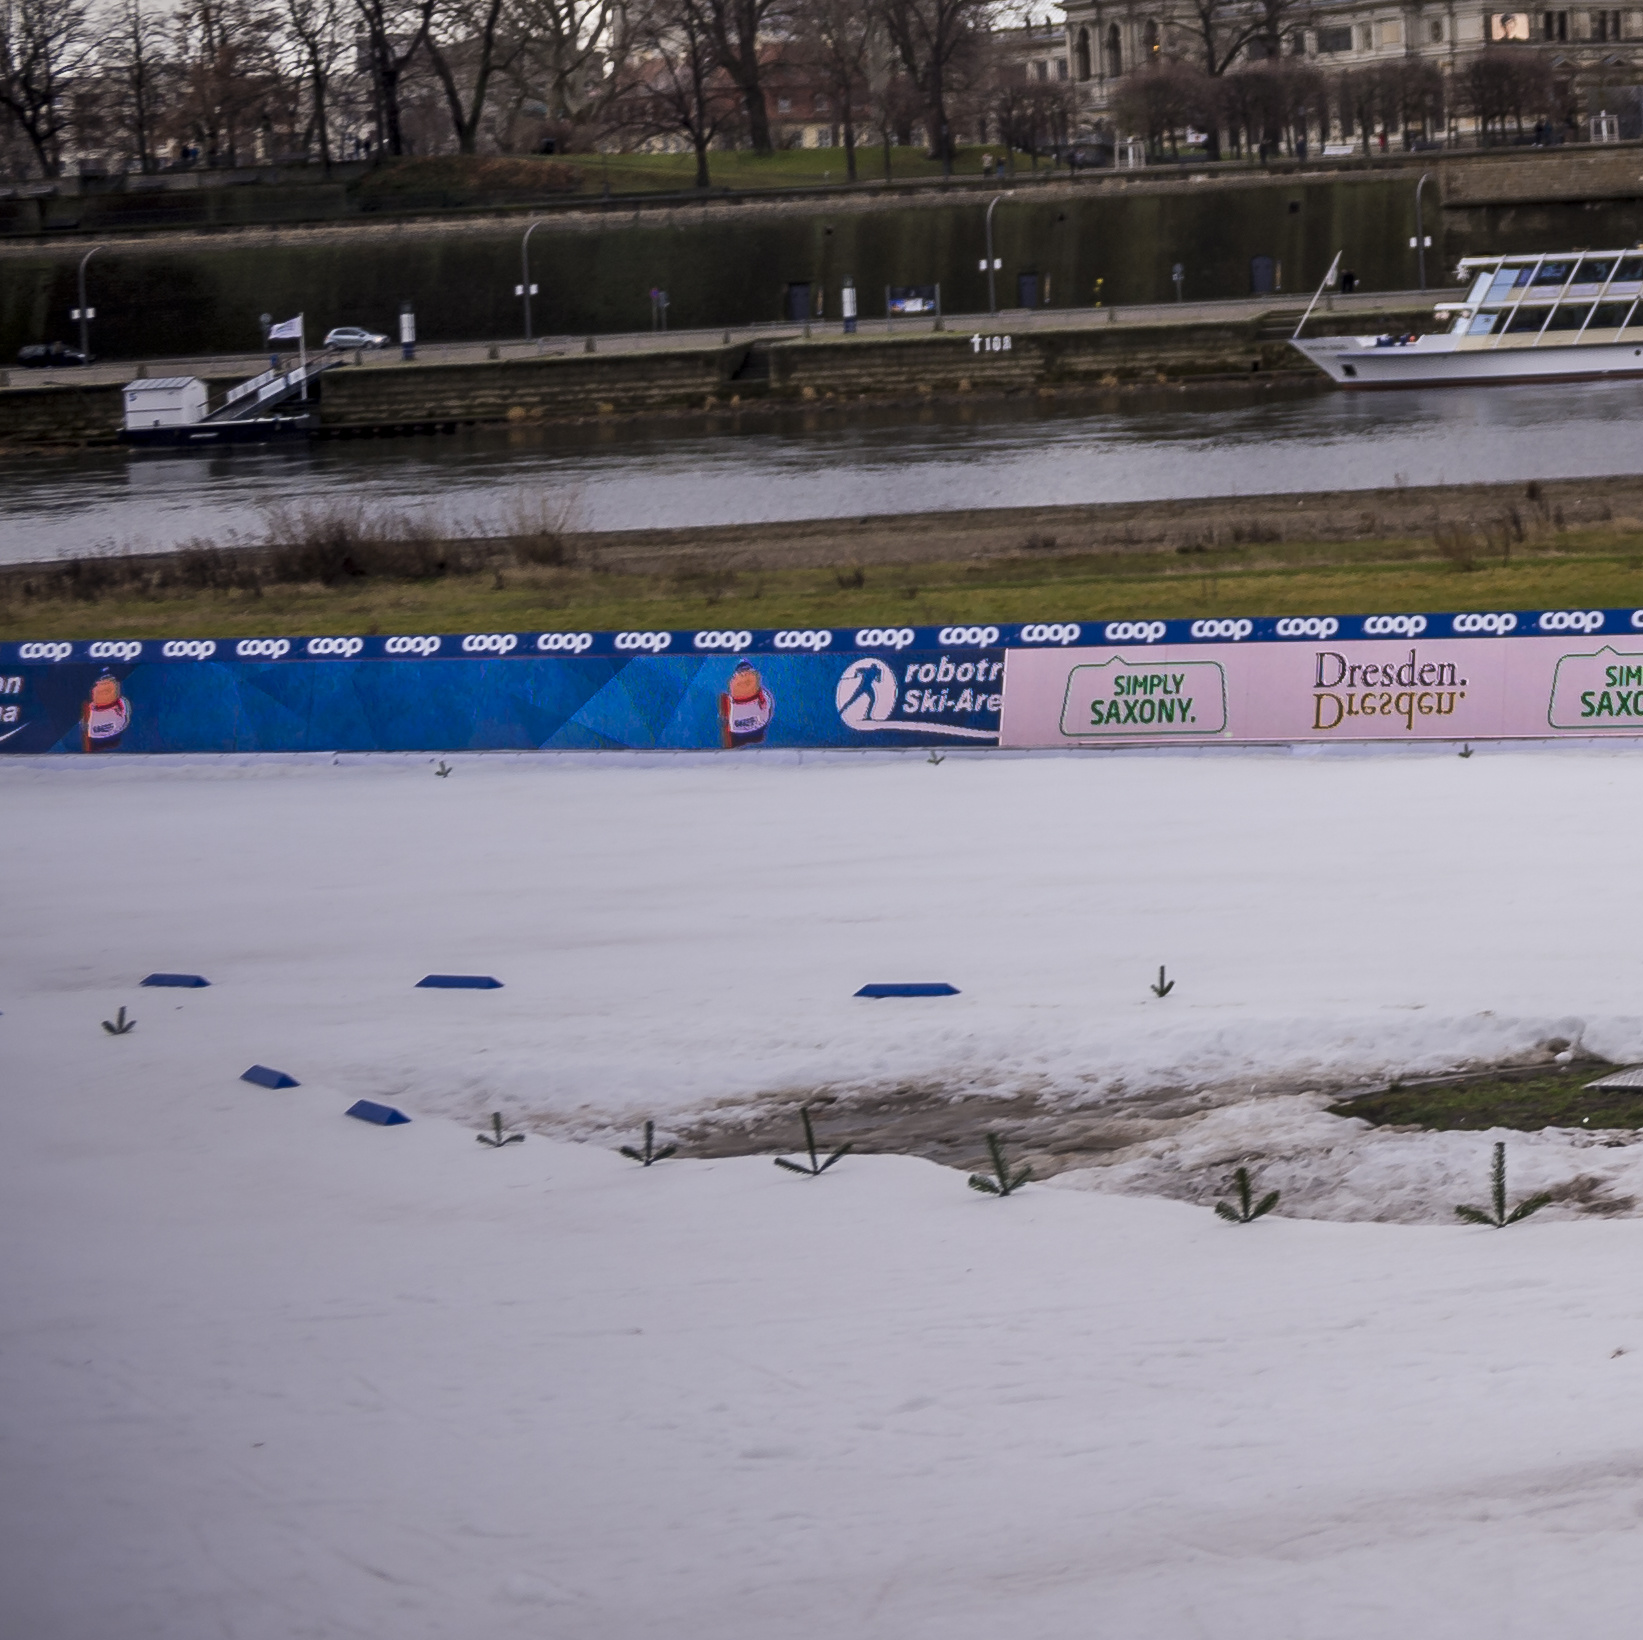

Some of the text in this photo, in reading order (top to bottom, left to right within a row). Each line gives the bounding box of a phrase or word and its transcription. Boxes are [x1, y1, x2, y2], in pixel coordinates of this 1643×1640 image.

[19, 643, 72, 662] coop
[89, 642, 142, 661] coop
[163, 641, 216, 660] coop
[236, 639, 290, 659] coop
[307, 637, 363, 658] coop
[385, 636, 441, 657] coop
[462, 634, 517, 655] coop
[537, 633, 592, 654] coop
[614, 632, 671, 653] coop
[694, 631, 752, 653] coop
[774, 630, 832, 651] coop
[855, 628, 914, 650] coop
[939, 626, 999, 648] coop
[1021, 624, 1080, 646] coop
[1105, 622, 1166, 644] coop
[1191, 620, 1252, 642] coop
[1276, 618, 1339, 640] coop
[1364, 615, 1427, 638] coop
[1453, 613, 1517, 636] coop
[1539, 611, 1604, 634] coop
[1313, 648, 1467, 687] Dresden.
[1113, 673, 1185, 696] SIMPLY
[1090, 698, 1197, 725] SAXONY.
